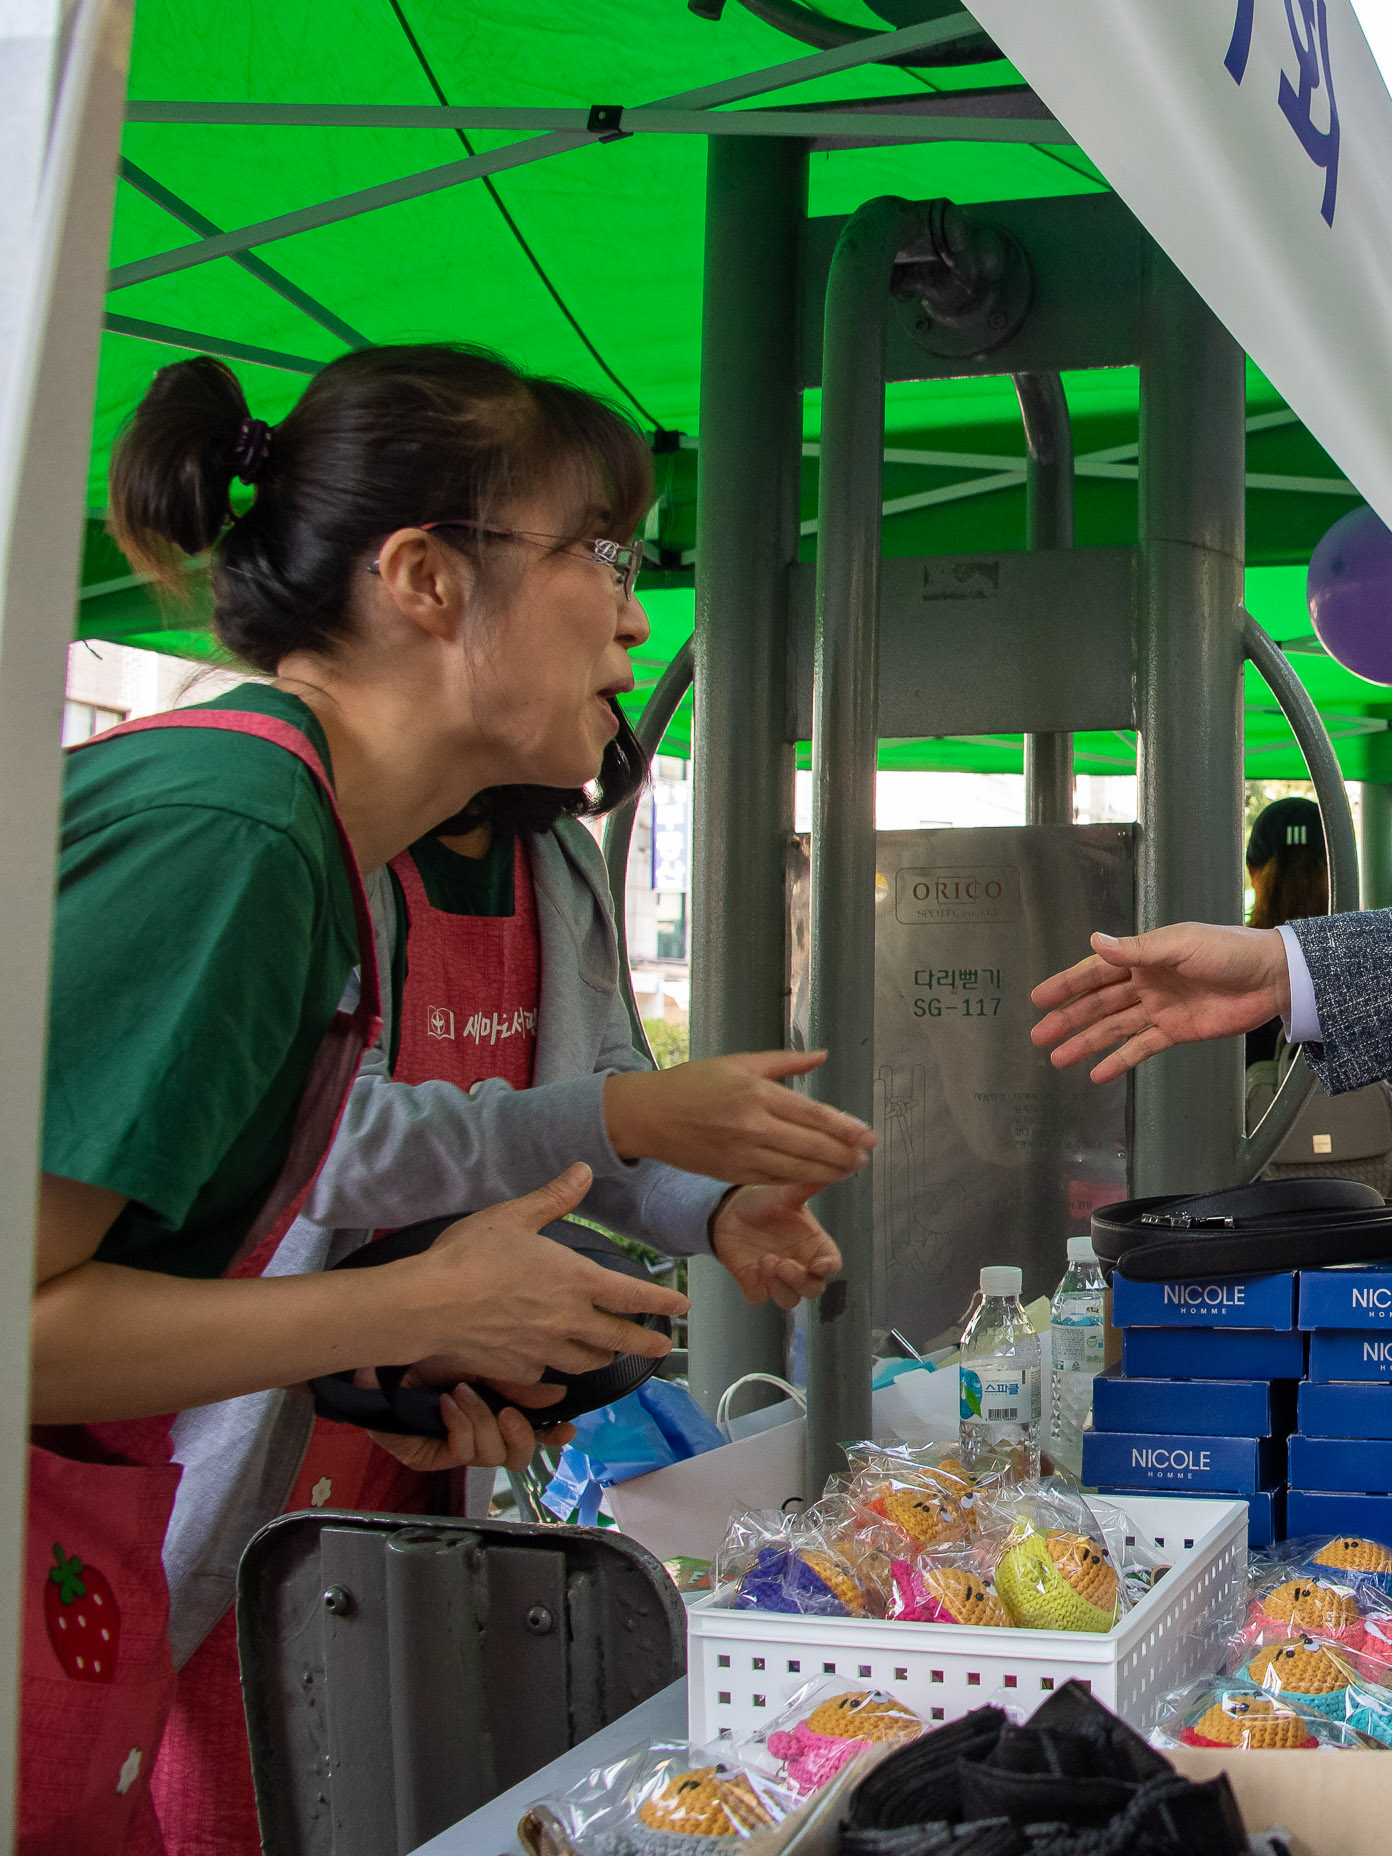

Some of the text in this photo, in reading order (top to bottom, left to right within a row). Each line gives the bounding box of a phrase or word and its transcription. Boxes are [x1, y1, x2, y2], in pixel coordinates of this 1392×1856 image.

[912, 880, 1003, 901] ORICO
[914, 968, 1001, 990] 다리뻗기
[913, 998, 1002, 1018] SG-117
[1164, 1285, 1245, 1305] NICOLE
[984, 1383, 1020, 1396] 스파클
[1131, 1448, 1211, 1470] NICOLE
[1147, 1471, 1193, 1479] HOMME
